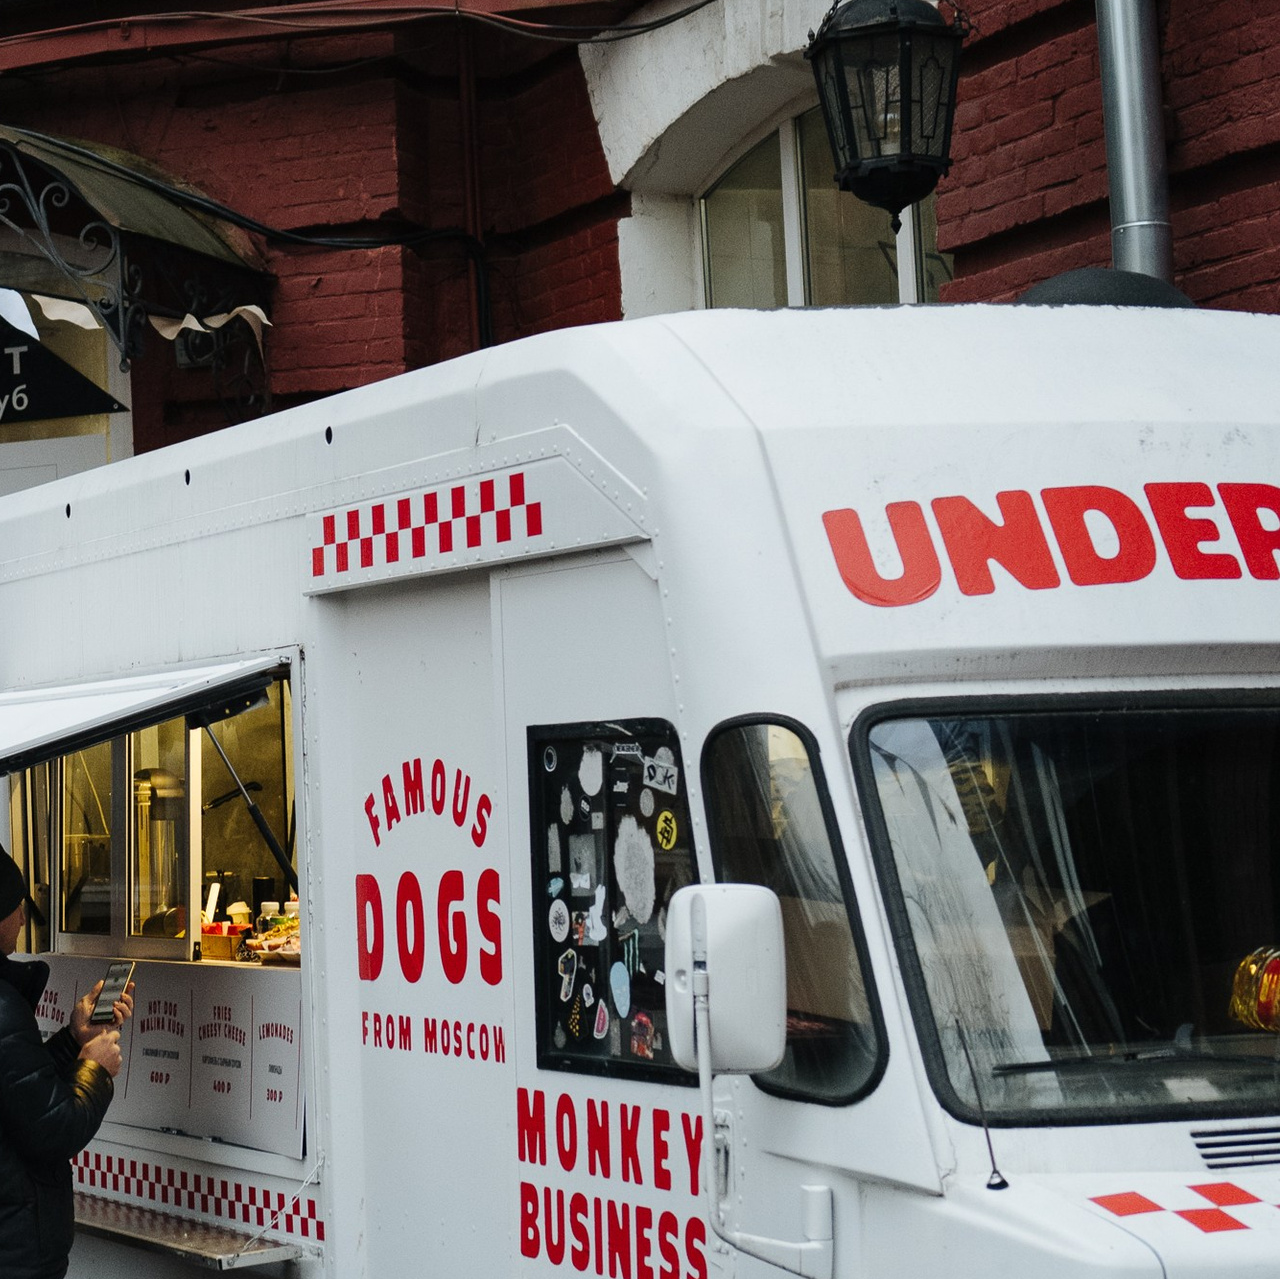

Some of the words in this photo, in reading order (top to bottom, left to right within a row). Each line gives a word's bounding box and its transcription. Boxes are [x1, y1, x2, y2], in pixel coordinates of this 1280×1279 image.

[364, 758, 492, 848] FAMOUS
[355, 868, 503, 986] DOGS
[259, 1022, 293, 1044] LEMONADES
[362, 1011, 411, 1051] FROM
[424, 1017, 505, 1063] MOSCOW
[517, 1087, 703, 1196] MONKEY
